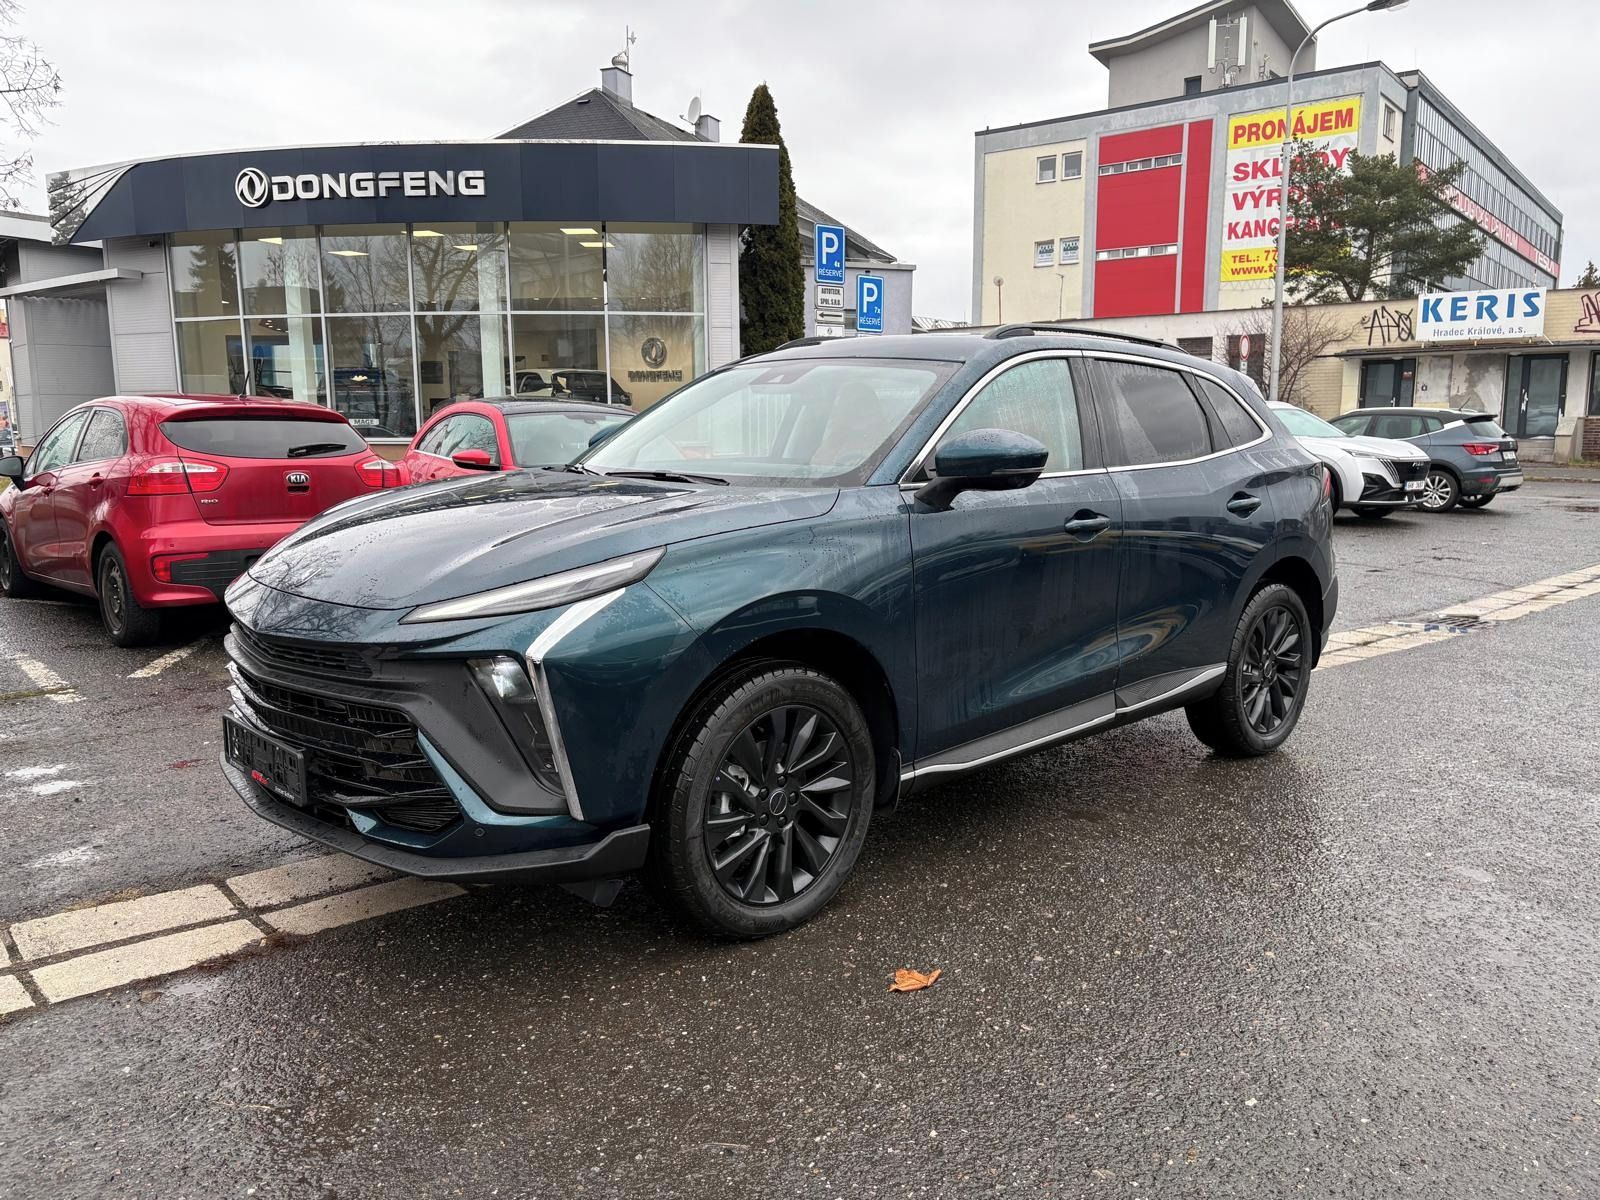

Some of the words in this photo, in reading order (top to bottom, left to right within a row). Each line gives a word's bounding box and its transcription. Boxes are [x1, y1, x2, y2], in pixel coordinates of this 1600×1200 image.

[1233, 107, 1354, 144] PRONÁJEM
[271, 170, 485, 201] DONGFENG
[821, 231, 839, 265] P
[1231, 255, 1260, 264] TEL.:
[862, 282, 878, 313] P
[1421, 292, 1541, 323] KERIS
[1433, 327, 1465, 338] Hradec
[1467, 325, 1506, 337] Králové,
[1508, 326, 1527, 335] a.s.
[290, 475, 306, 483] KIA
